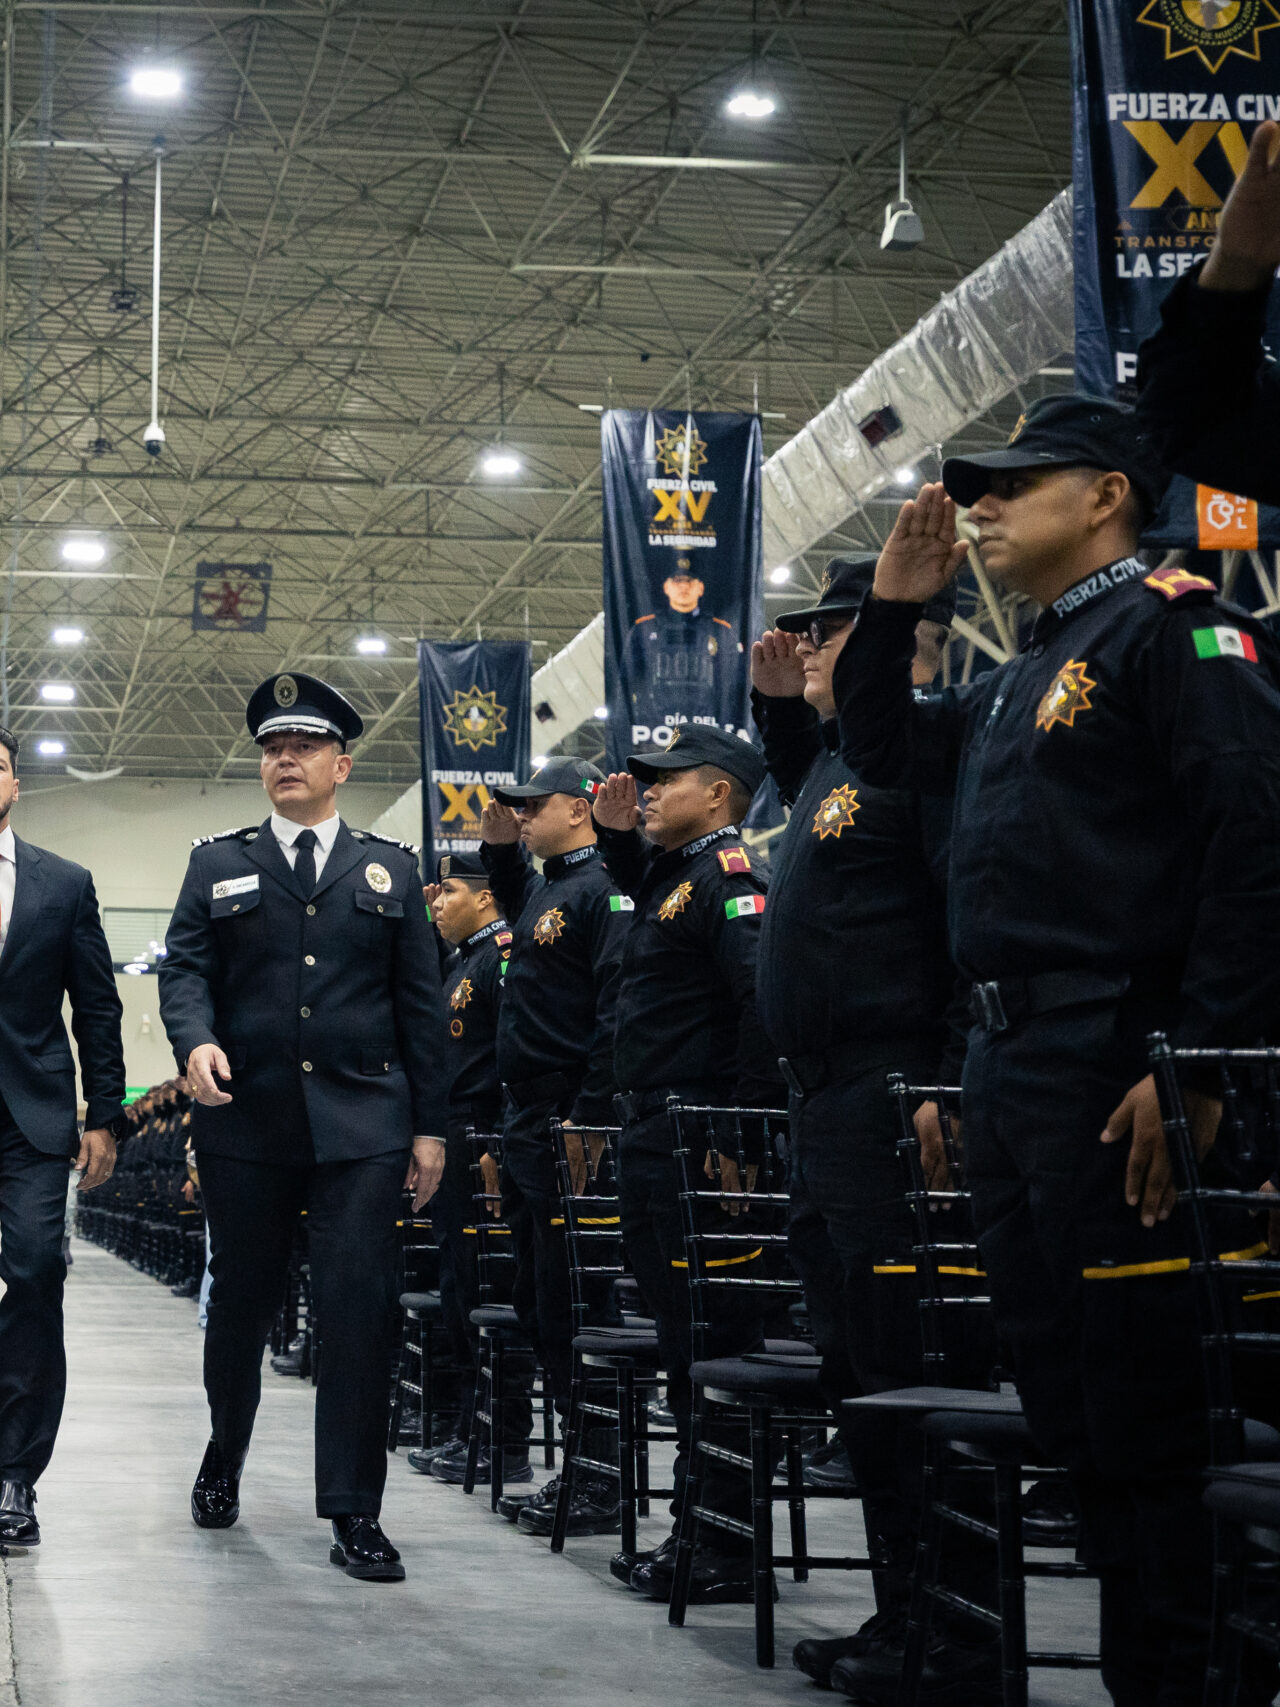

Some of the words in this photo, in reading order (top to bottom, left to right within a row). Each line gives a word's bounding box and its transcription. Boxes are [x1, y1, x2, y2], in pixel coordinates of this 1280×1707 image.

[1108, 93, 1231, 120] FUERZA
[1114, 235, 1219, 248] TRANSFO
[1117, 254, 1154, 278] LA
[647, 479, 690, 490] FUERZA
[690, 481, 718, 492] CIVIL
[652, 489, 713, 522] XV
[648, 534, 663, 546] LA
[663, 535, 717, 547] SEGURIDAD
[1052, 572, 1113, 618] FUERZA
[1110, 557, 1146, 583] CIVIL
[665, 711, 688, 726] DÍA
[693, 716, 719, 728] DEL
[432, 770, 483, 785] FUERZA
[484, 772, 518, 786] CIVIL
[433, 839, 450, 851] LA
[564, 846, 596, 865] FUERZA
